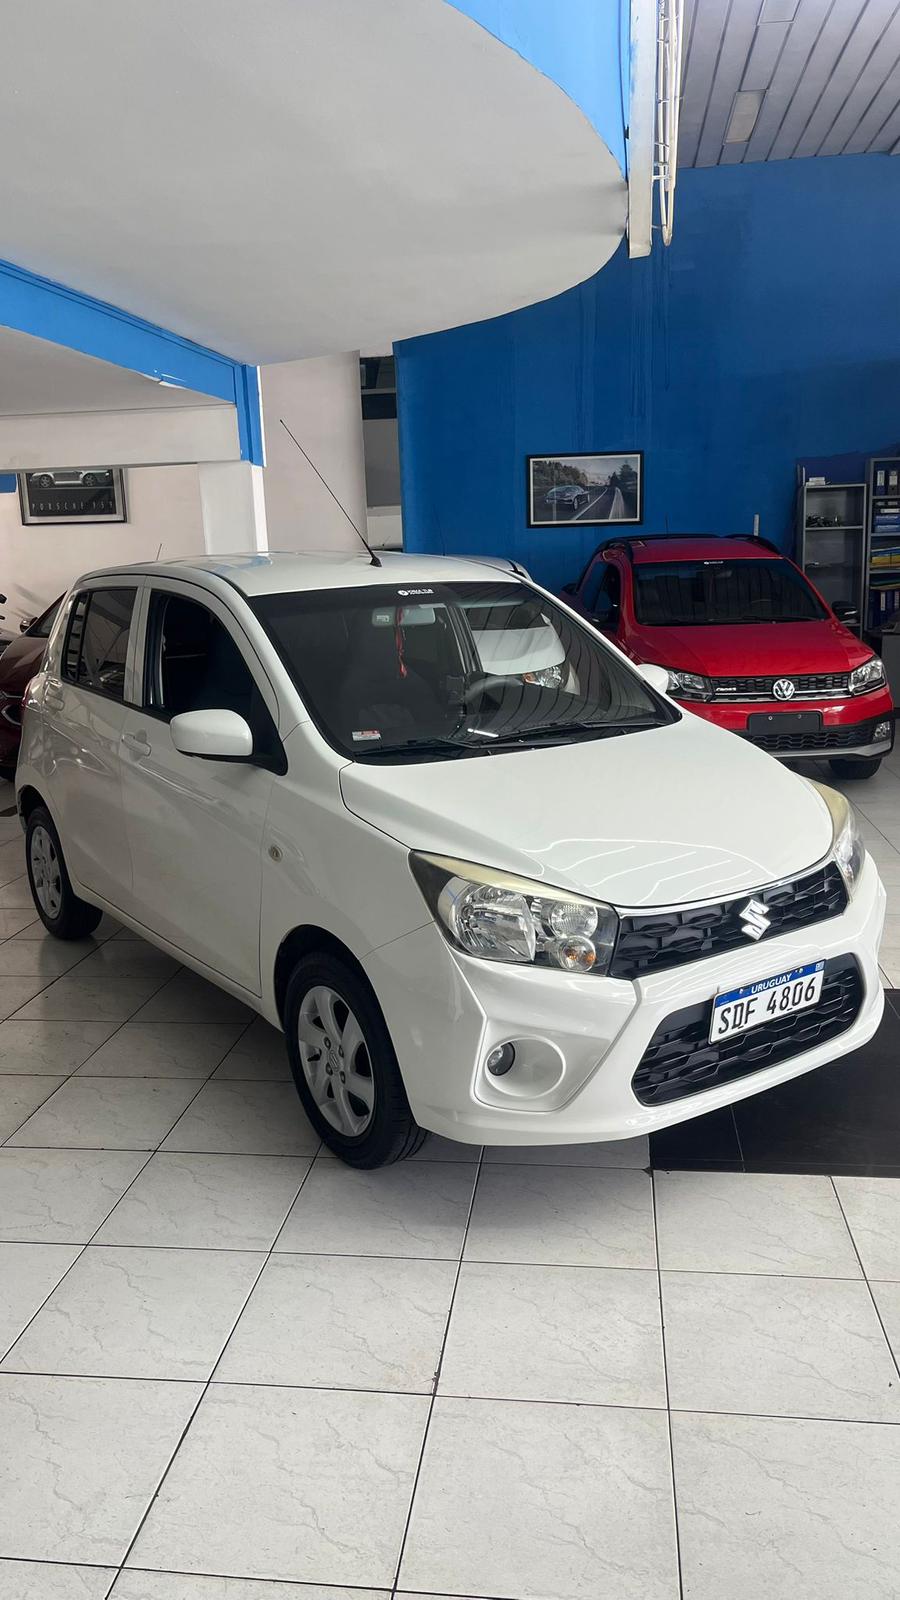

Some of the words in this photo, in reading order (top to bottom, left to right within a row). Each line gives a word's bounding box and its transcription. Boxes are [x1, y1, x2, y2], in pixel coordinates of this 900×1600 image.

[32, 501, 84, 511] PORSCHE
[751, 973, 792, 994] URUGUAY
[718, 996, 758, 1035] SDF
[766, 977, 817, 1015] 4806
